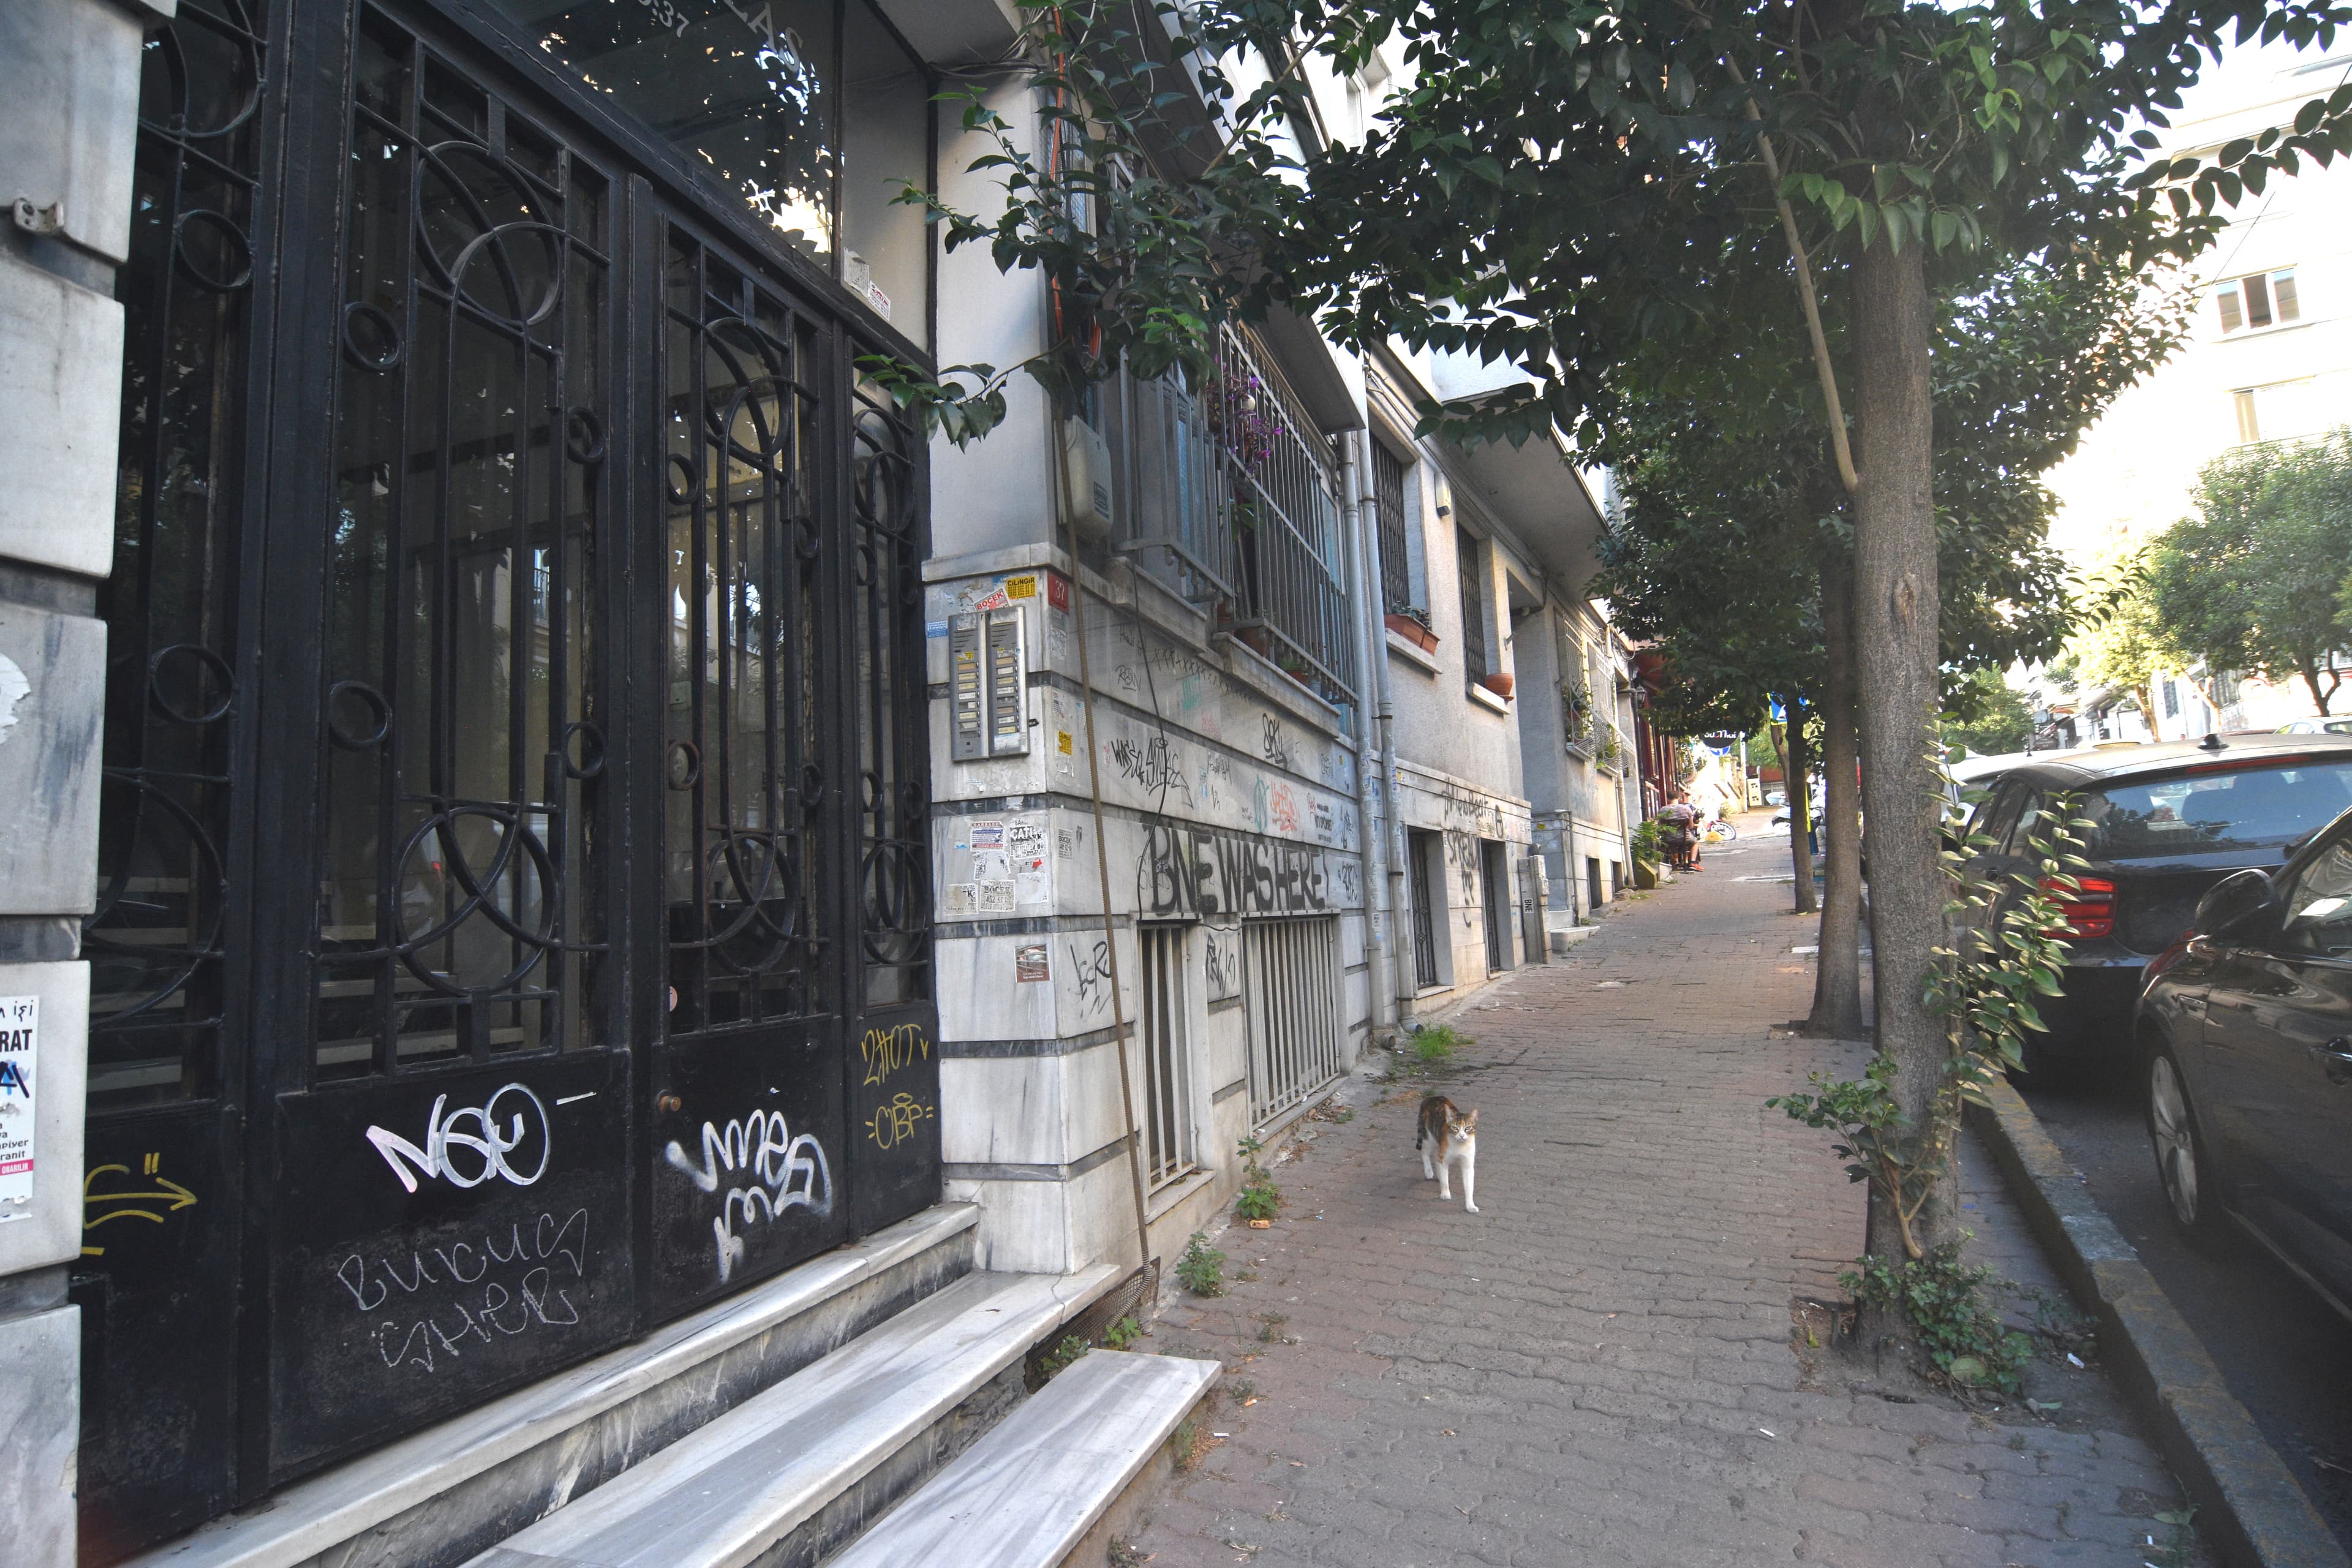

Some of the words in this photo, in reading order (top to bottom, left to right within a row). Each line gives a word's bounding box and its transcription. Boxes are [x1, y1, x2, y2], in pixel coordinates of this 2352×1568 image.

[1056, 580, 1065, 601] 37
[1143, 820, 1218, 916] BNE
[1215, 828, 1275, 914] WAS
[1273, 837, 1325, 913] HERE
[1524, 899, 1532, 913] BNE
